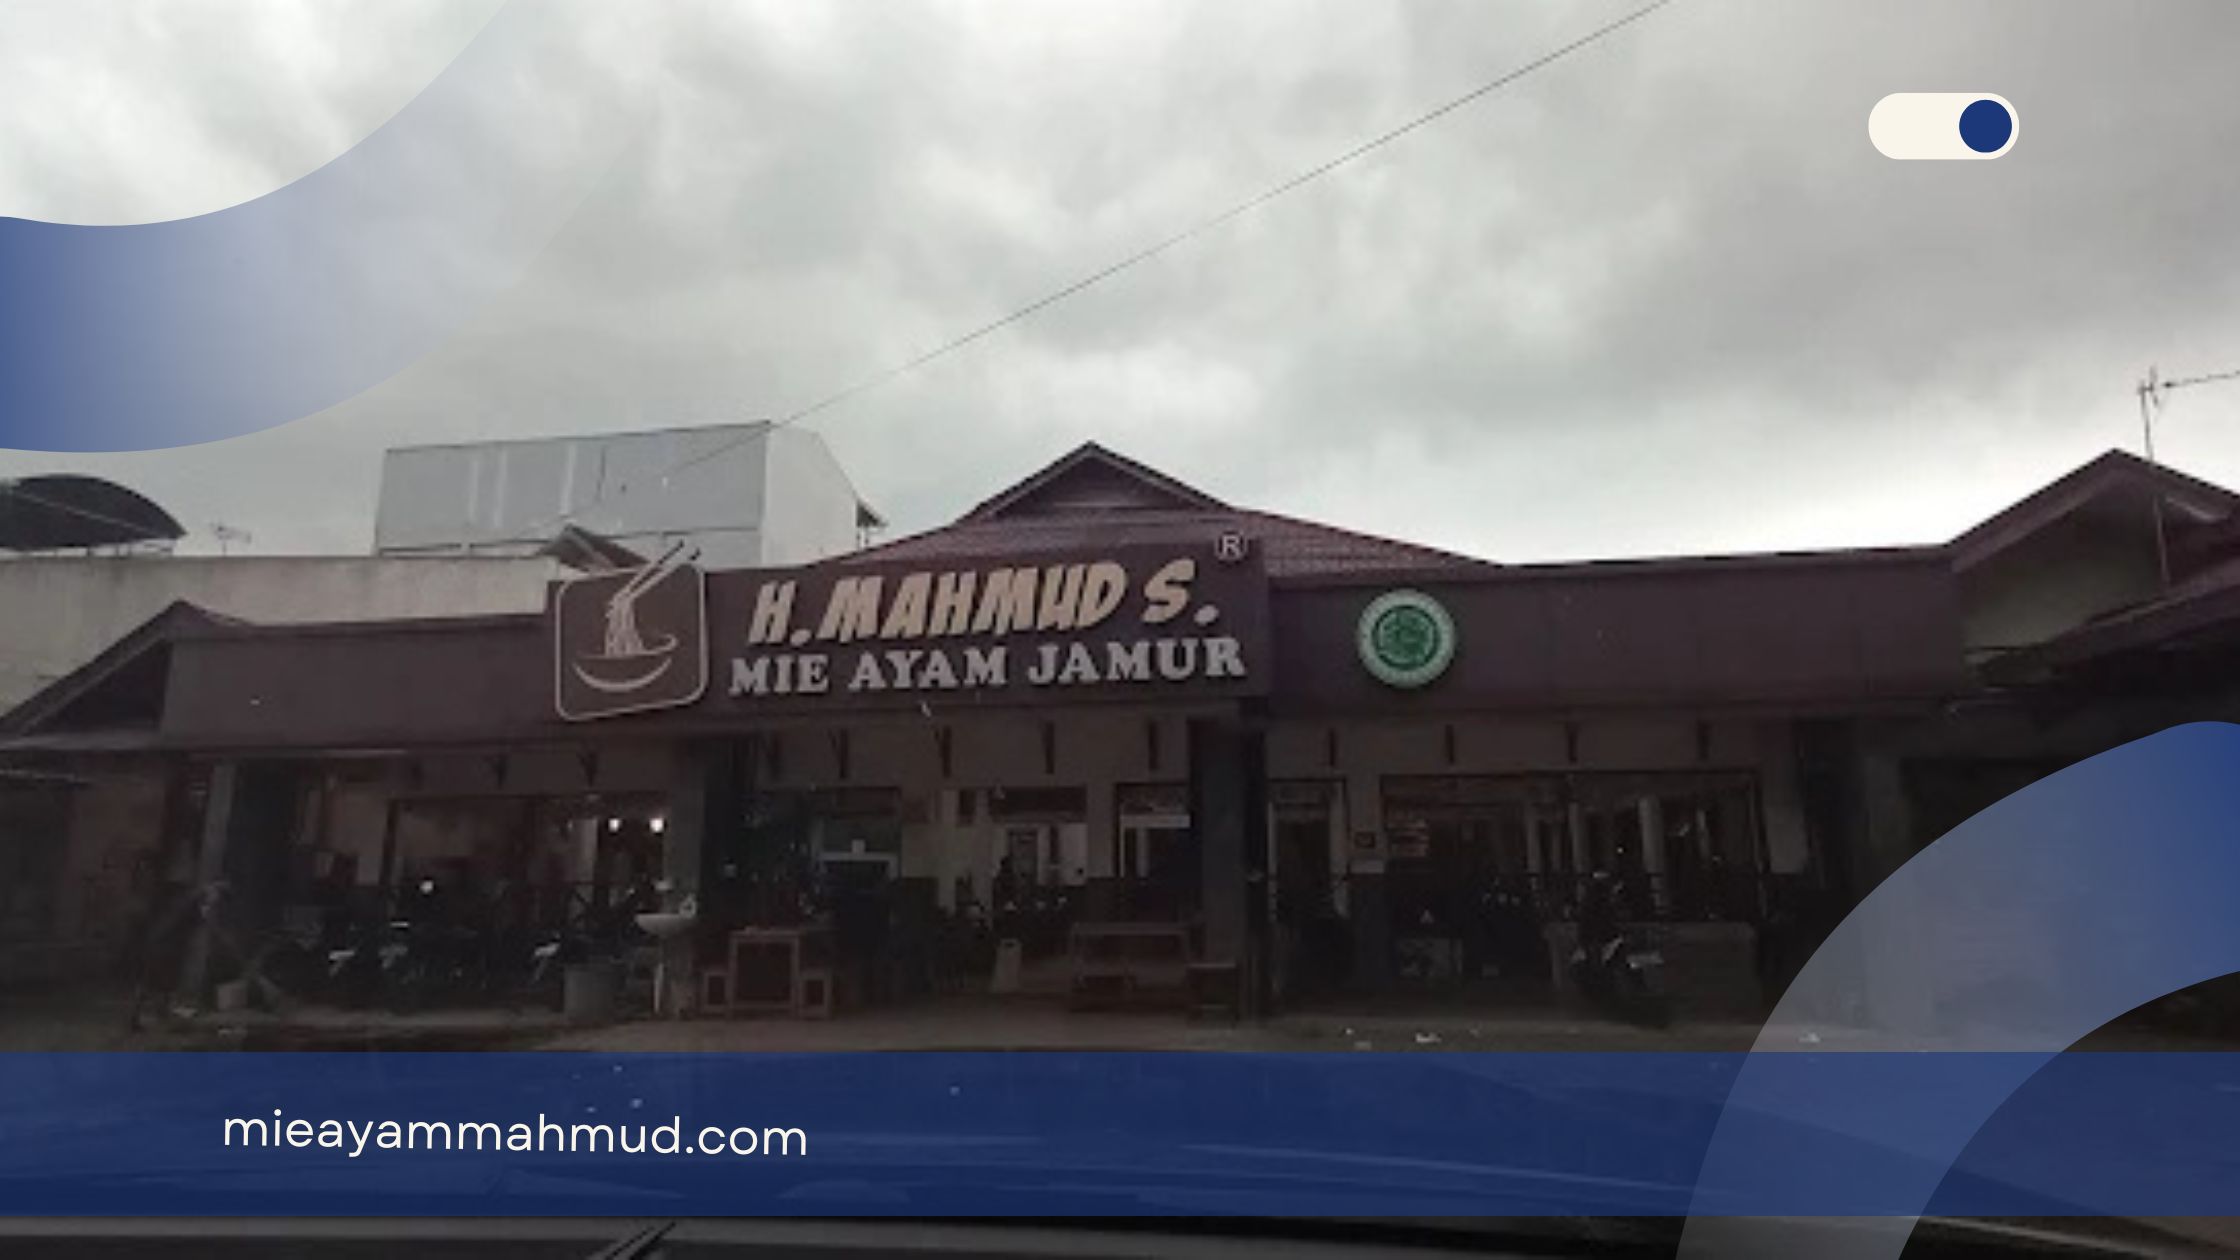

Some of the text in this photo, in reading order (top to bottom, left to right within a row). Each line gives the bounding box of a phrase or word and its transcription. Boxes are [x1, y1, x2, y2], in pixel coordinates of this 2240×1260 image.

[1141, 558, 1220, 626] S.
[728, 636, 1248, 697] MIE AYAM JAMUR
